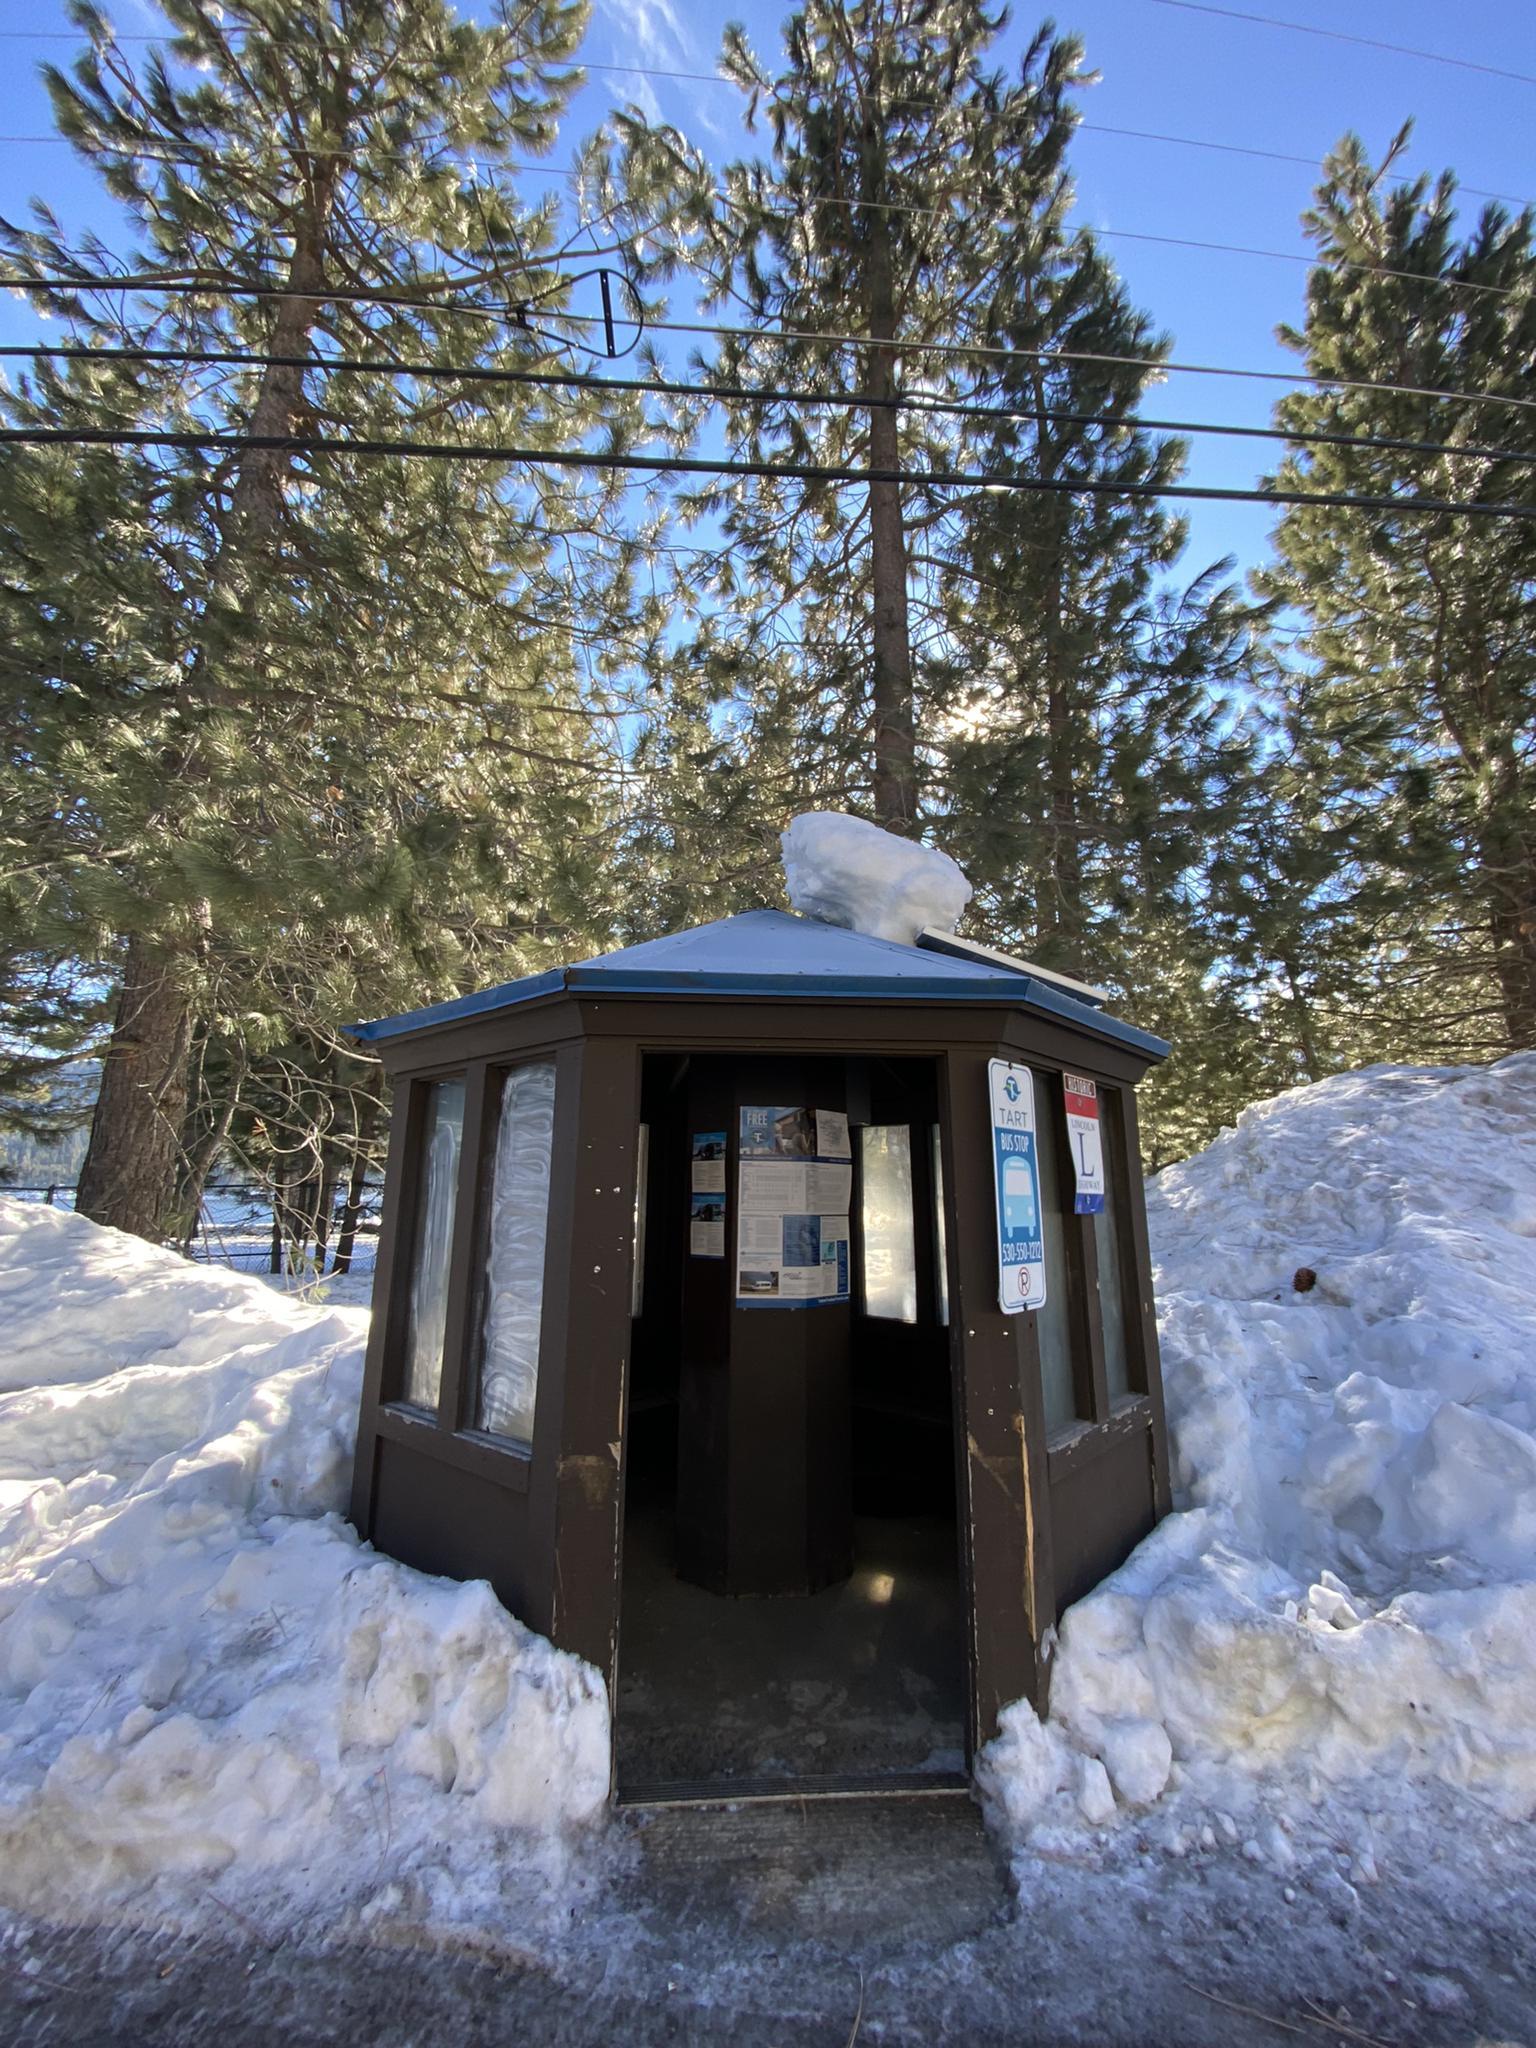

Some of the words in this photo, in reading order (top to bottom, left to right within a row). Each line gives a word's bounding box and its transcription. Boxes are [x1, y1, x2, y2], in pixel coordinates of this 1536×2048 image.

[1068, 1076, 1093, 1096] HISTORIC
[747, 1112, 768, 1125] FREE
[999, 1107, 1028, 1128] TART
[1070, 1118, 1095, 1131] LINCOLN
[1001, 1132, 1013, 1151] BUS
[1014, 1134, 1029, 1153] STOP
[1078, 1132, 1095, 1177] L
[1002, 1241, 1042, 1262] 530-550-1212
